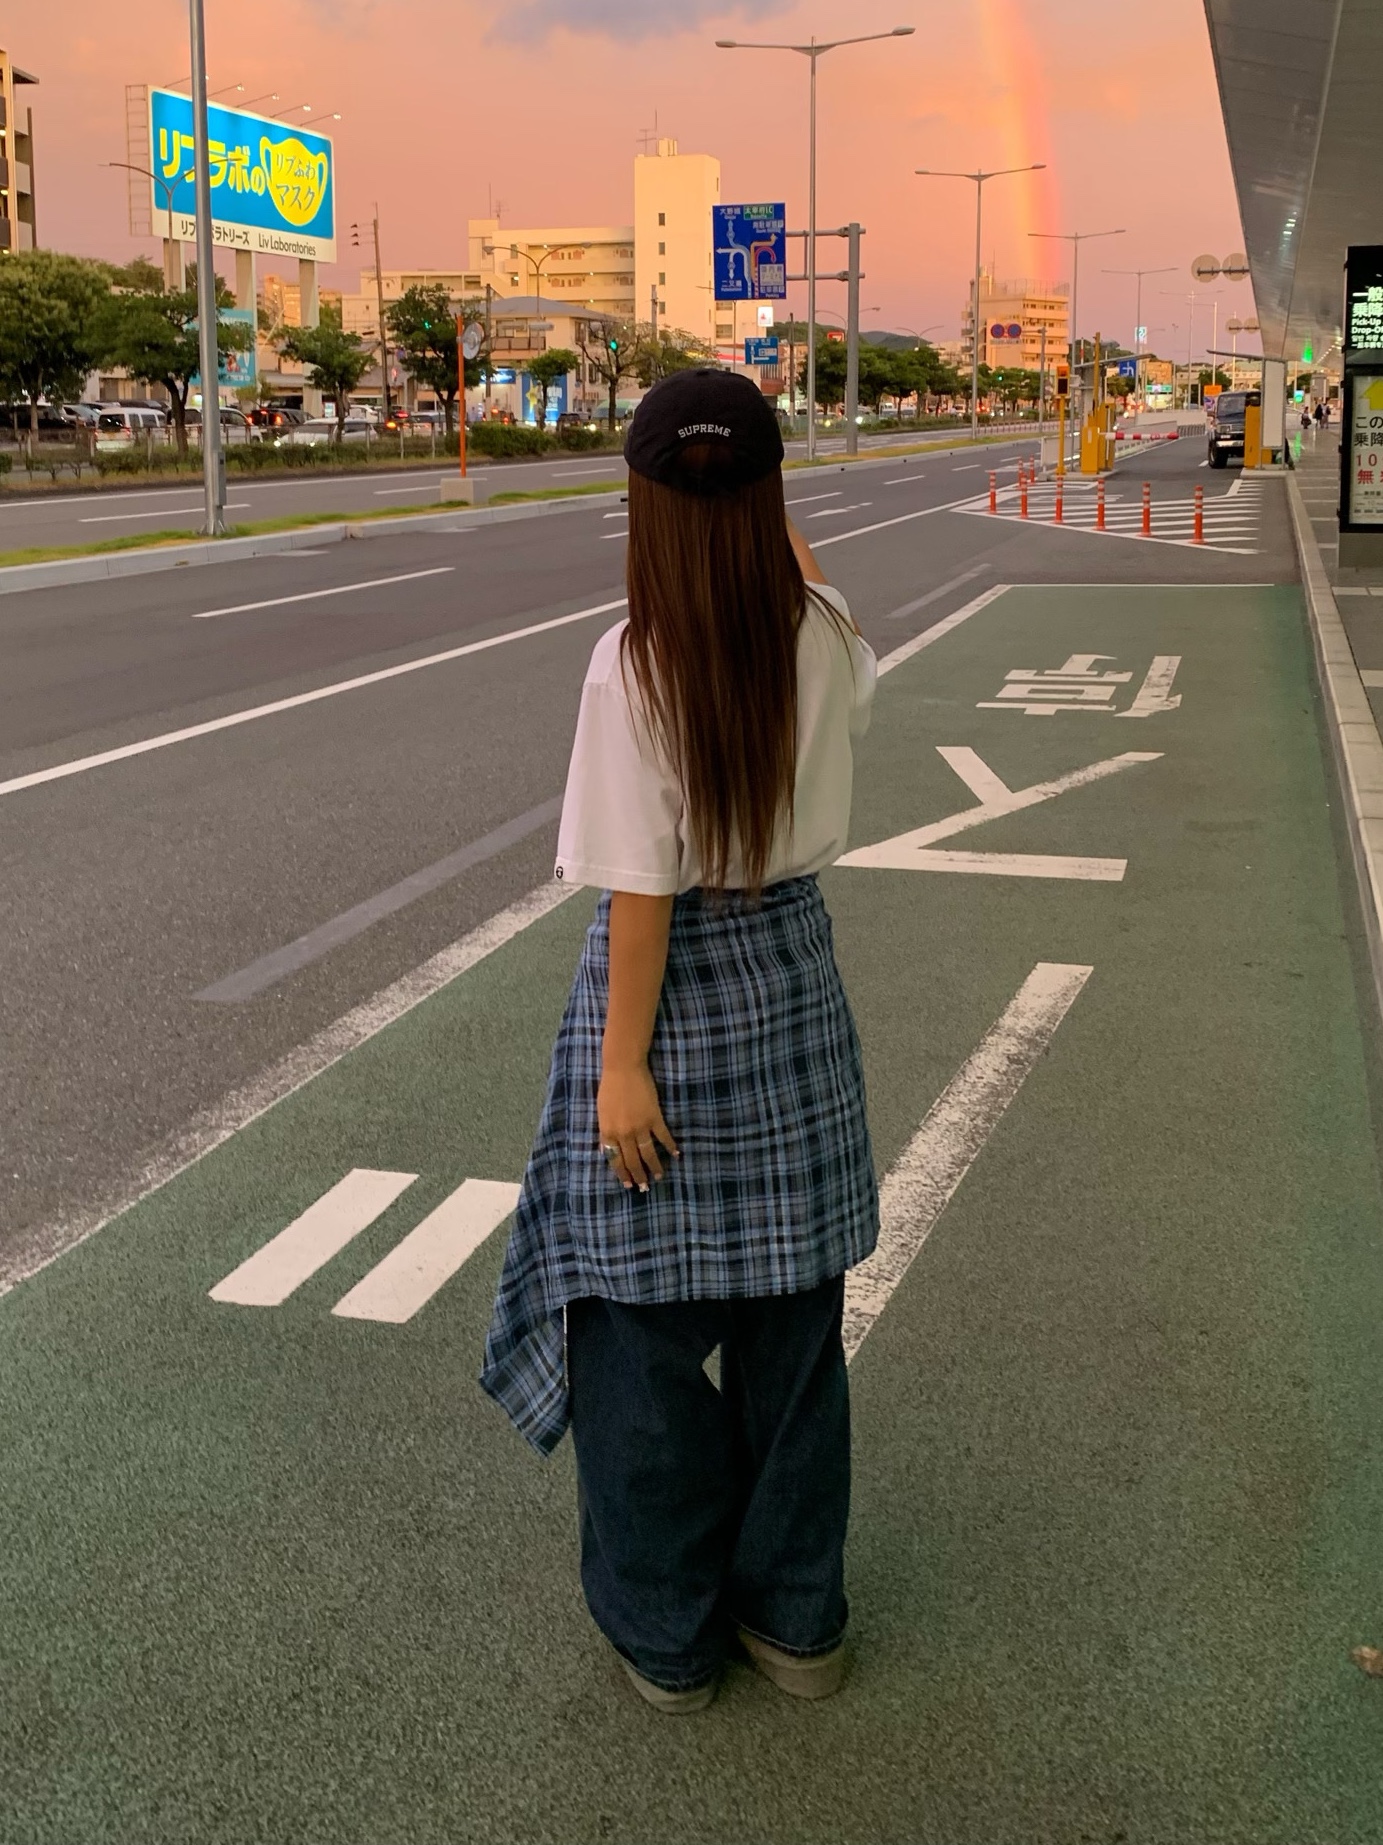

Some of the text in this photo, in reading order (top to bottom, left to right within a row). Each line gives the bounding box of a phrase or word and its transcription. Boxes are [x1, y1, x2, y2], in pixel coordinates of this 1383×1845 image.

[276, 184, 316, 212] マスク
[258, 233, 317, 256] Liv Laboratories
[1351, 318, 1382, 326] Pick-Up
[677, 423, 732, 439] SUPREME
